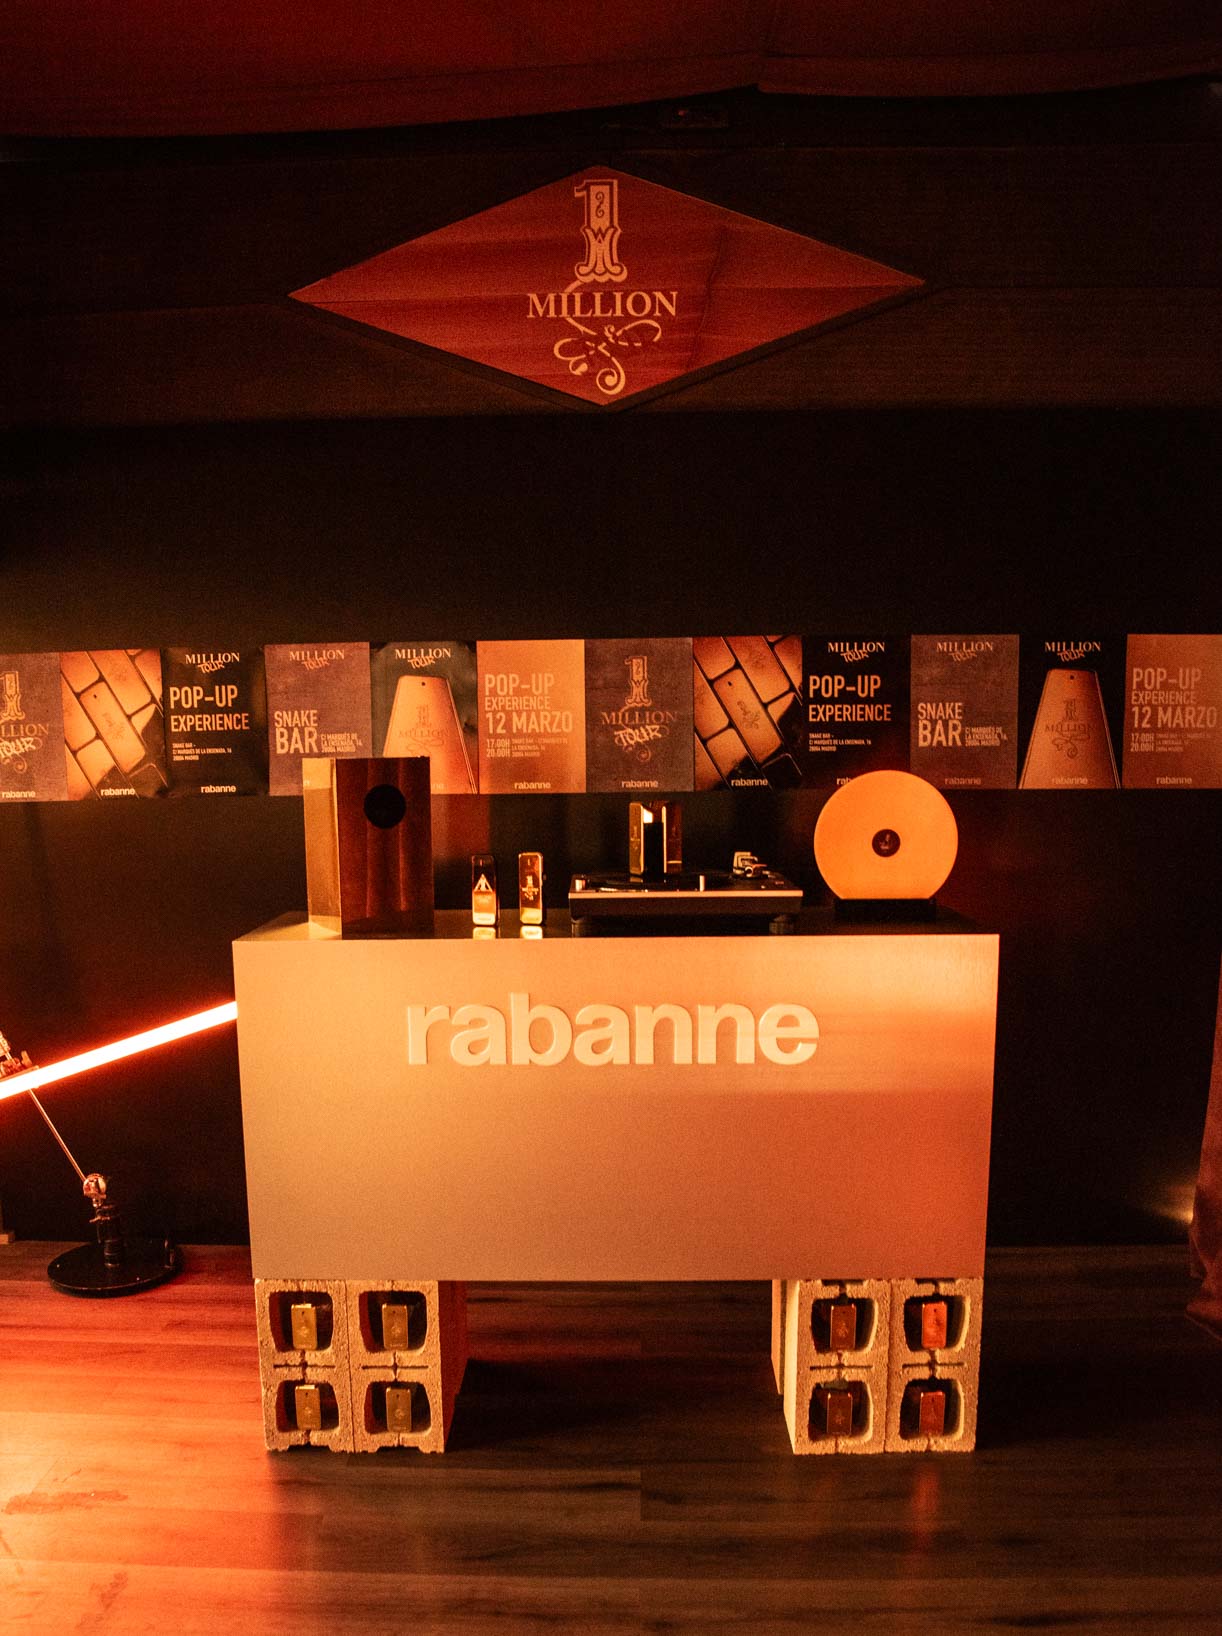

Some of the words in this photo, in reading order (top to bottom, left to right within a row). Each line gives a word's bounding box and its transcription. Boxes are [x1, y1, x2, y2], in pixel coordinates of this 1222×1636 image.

[526, 290, 678, 318] MILLION
[827, 642, 885, 653] MILLION
[936, 641, 994, 652] MILLION
[1045, 641, 1101, 652] MILLION
[185, 652, 241, 665] MILLION
[289, 648, 345, 660] MILLION
[395, 648, 451, 660] MILLION
[484, 673, 555, 696] POP-UP
[1131, 667, 1201, 690] POP-UP
[808, 675, 881, 698] POP-UP
[169, 685, 239, 710] POP-UP
[484, 696, 551, 711] EXPERIENCE
[1131, 691, 1197, 705] EXPERIENCE
[601, 711, 678, 725] MILLION
[808, 704, 892, 722] EXPERIENCE
[917, 702, 963, 720] SNAKE
[1131, 707, 1151, 729] 12
[1157, 707, 1217, 728] MARZO
[170, 712, 250, 733] EXPERIENCE
[274, 710, 318, 728] SNAKE
[485, 712, 506, 734] 12
[512, 711, 573, 733] MARZO
[0, 723, 50, 737] LLION
[918, 719, 962, 747] BAR
[275, 727, 318, 755] BAR
[514, 781, 551, 790] rabanne
[621, 779, 659, 788] rabanne
[730, 778, 769, 787] rabanne
[944, 777, 982, 786] rabanne
[1156, 777, 1193, 785] rabanne
[1, 790, 36, 799] rabanne
[100, 788, 136, 797] rabanne
[200, 785, 236, 793] rabanne
[406, 991, 820, 1067] rabanne
